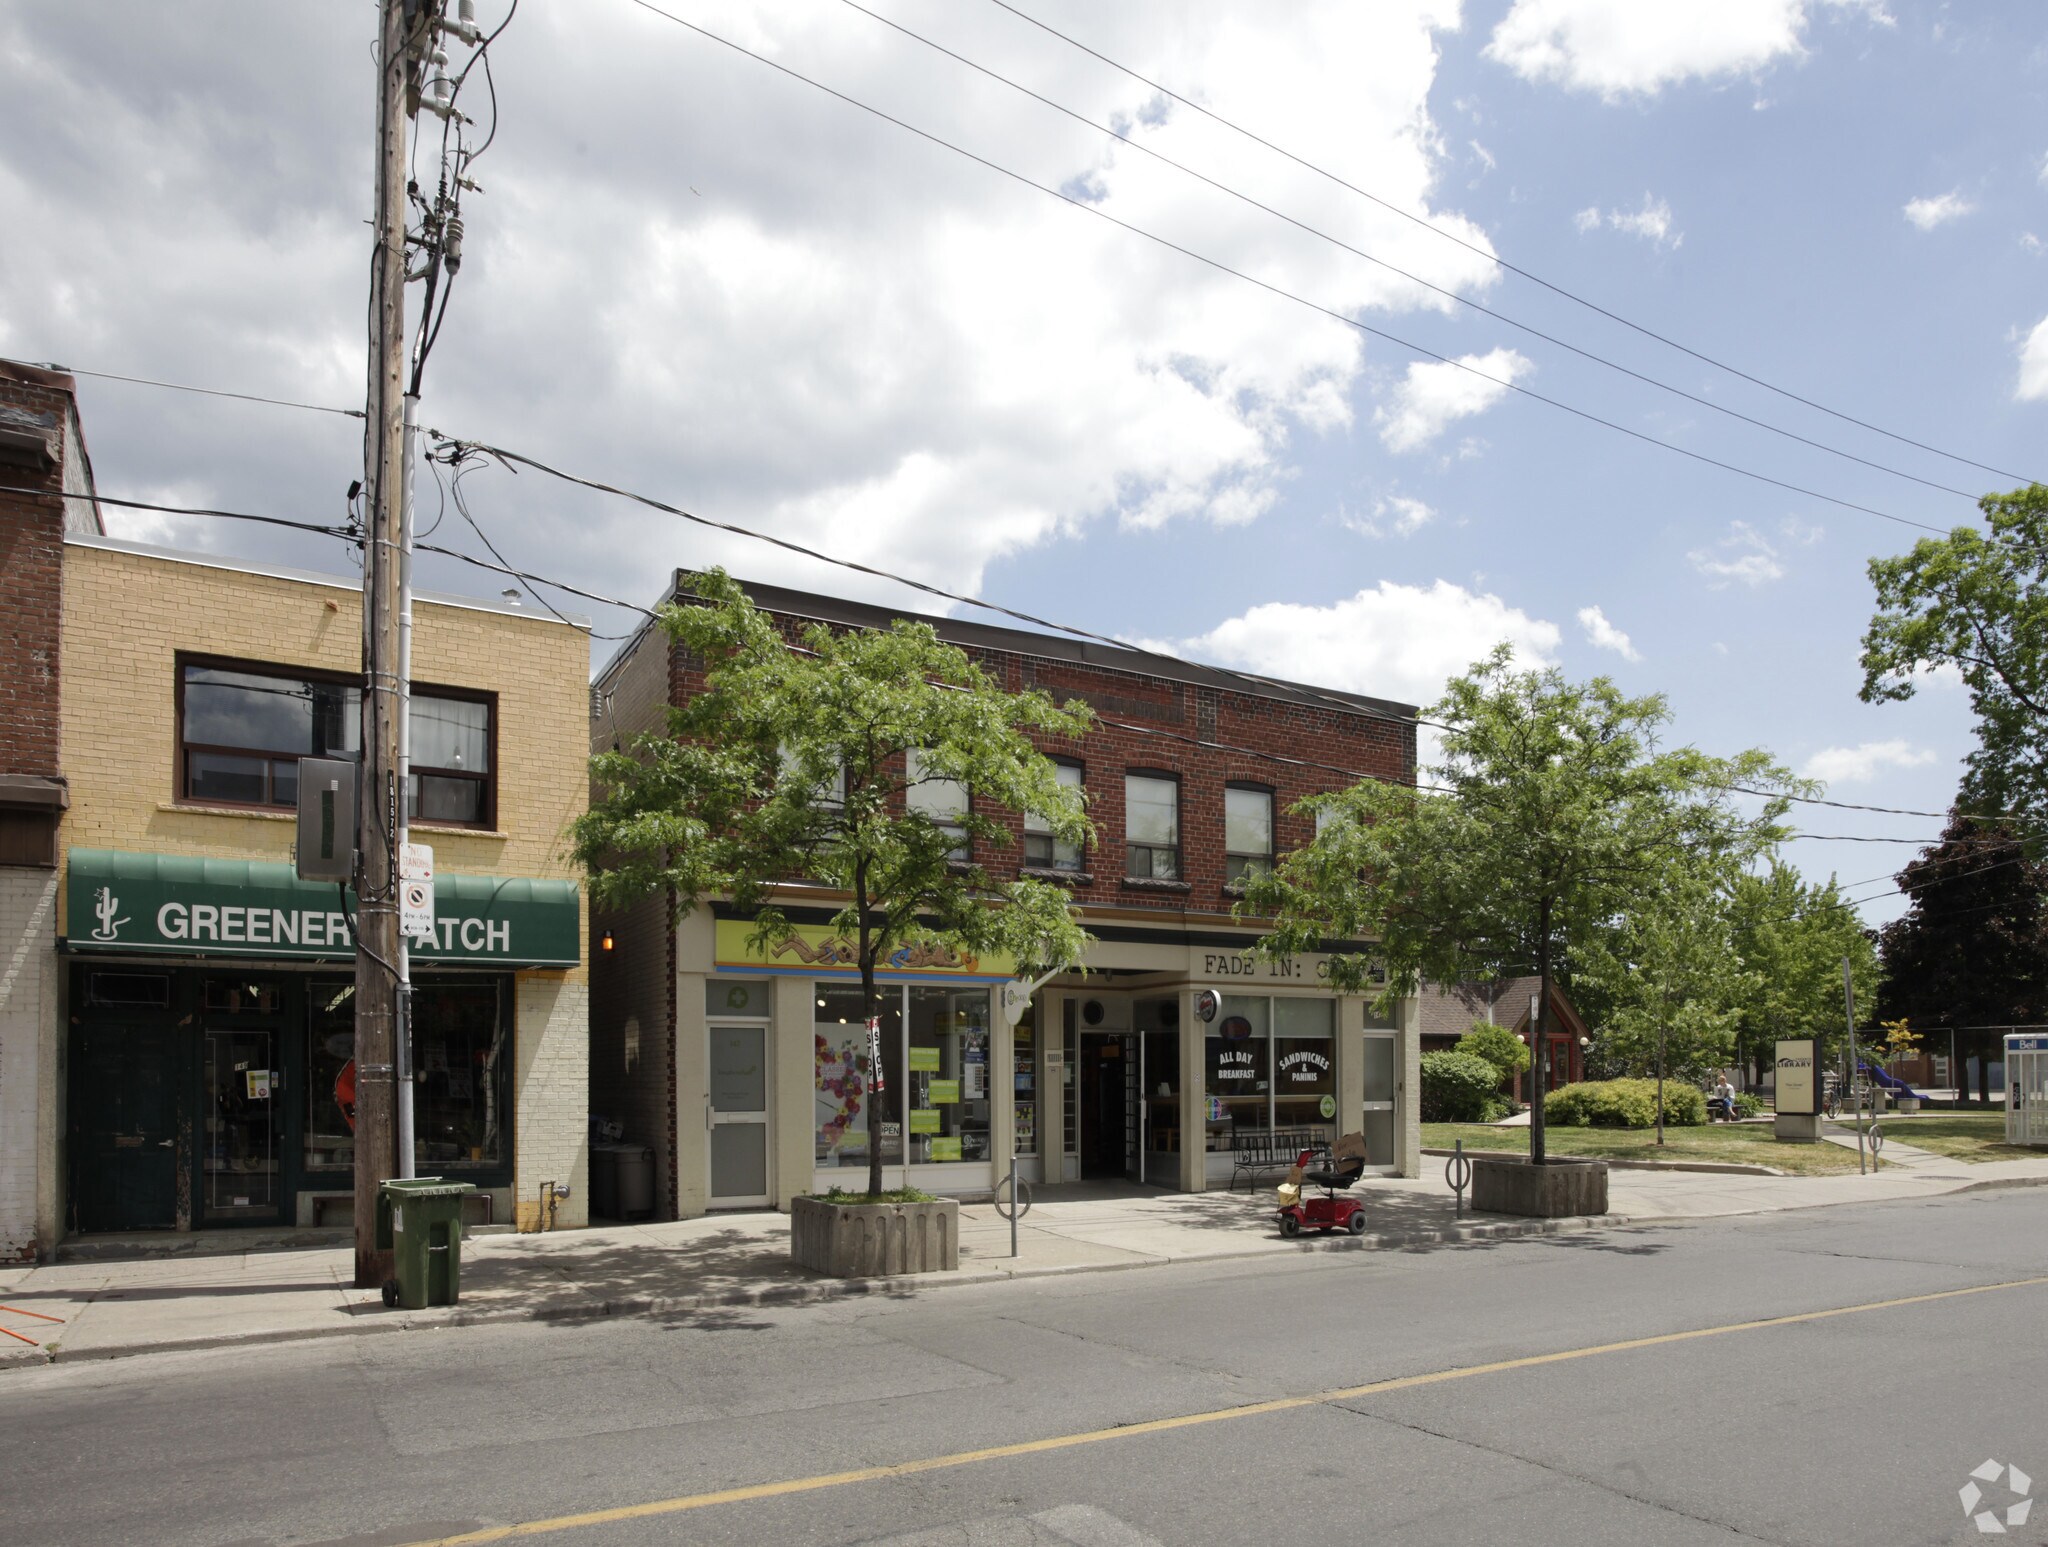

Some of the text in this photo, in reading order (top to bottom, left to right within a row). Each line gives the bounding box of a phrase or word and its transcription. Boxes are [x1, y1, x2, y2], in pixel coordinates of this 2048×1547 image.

[156, 902, 510, 952] GREENER ATCH
[1204, 954, 1255, 976] FADE
[2019, 1040, 2037, 1050] Bell
[874, 1031, 882, 1076] STOP
[1219, 1051, 1253, 1065] ALL DAY
[1279, 1051, 1330, 1071] SANDWICHES
[1301, 1063, 1308, 1073] &
[1218, 1069, 1255, 1079] BREAKFAST
[1291, 1072, 1318, 1081] PANINIS
